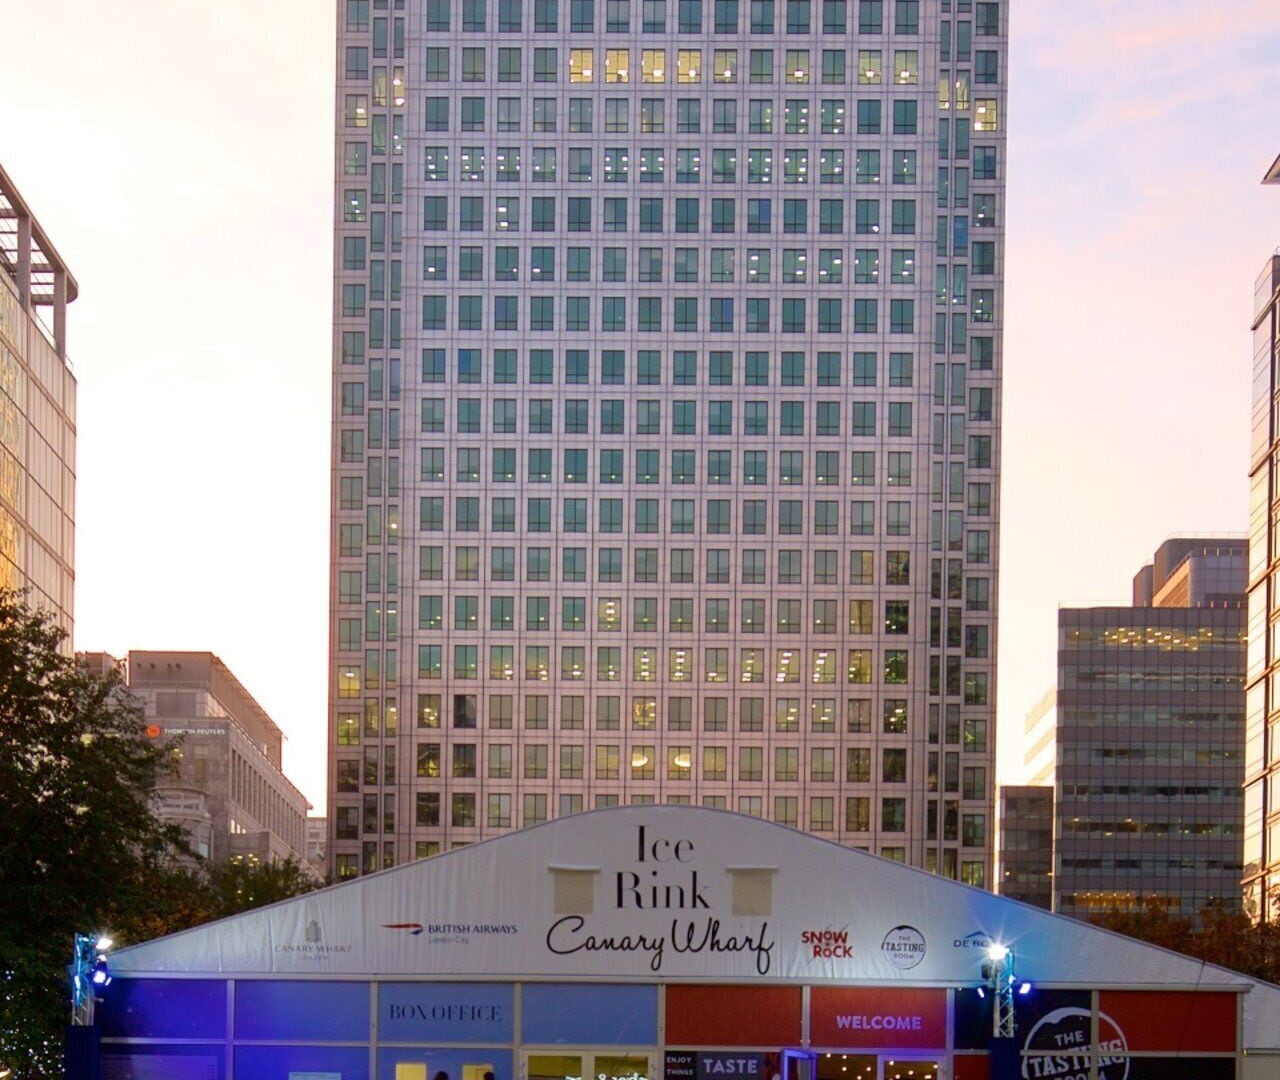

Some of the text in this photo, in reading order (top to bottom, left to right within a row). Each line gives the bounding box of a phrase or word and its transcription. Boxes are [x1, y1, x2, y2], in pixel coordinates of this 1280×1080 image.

[635, 824, 695, 863] Ice
[613, 870, 714, 909] Rink
[428, 924, 518, 934] BRITISH AIRWAYS
[455, 936, 470, 945] City
[801, 930, 848, 944] SNOW
[954, 939, 970, 948] DE
[274, 945, 352, 953] CANARY WHARF
[546, 915, 774, 975] Canary Wharf
[812, 944, 853, 959] ROCK
[885, 941, 924, 953] TASTING
[390, 1004, 502, 1021] BOX OFFICE
[836, 1015, 922, 1030] WELCOME
[1054, 1030, 1085, 1046] THE
[666, 1056, 692, 1064] ENJOY
[703, 1058, 758, 1074] TASTE
[666, 1068, 694, 1076] THINGS
